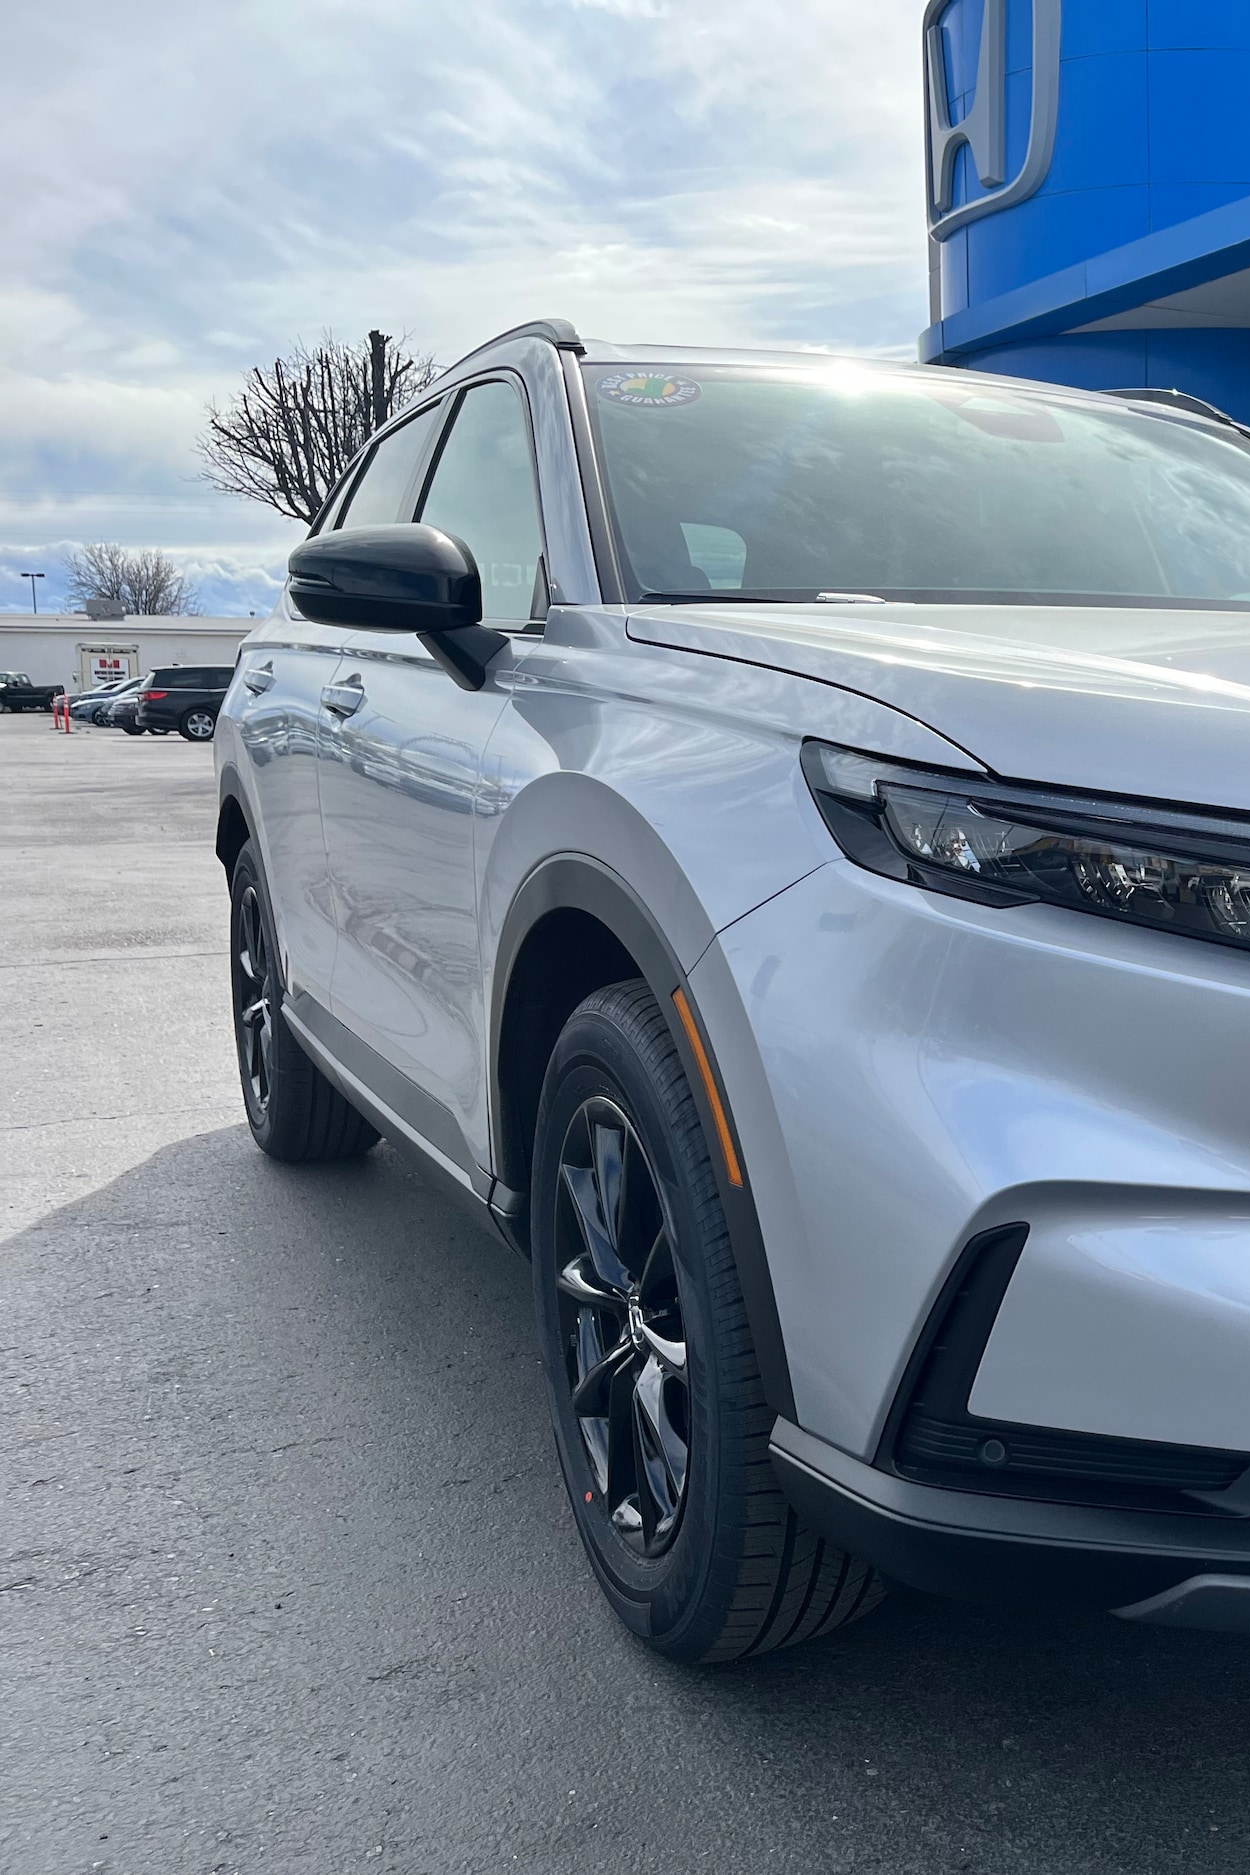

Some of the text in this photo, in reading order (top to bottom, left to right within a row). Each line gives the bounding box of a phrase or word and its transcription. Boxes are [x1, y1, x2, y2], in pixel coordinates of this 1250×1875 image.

[601, 372, 675, 389] BEST PRICE
[620, 386, 697, 404] GUARANTEE
